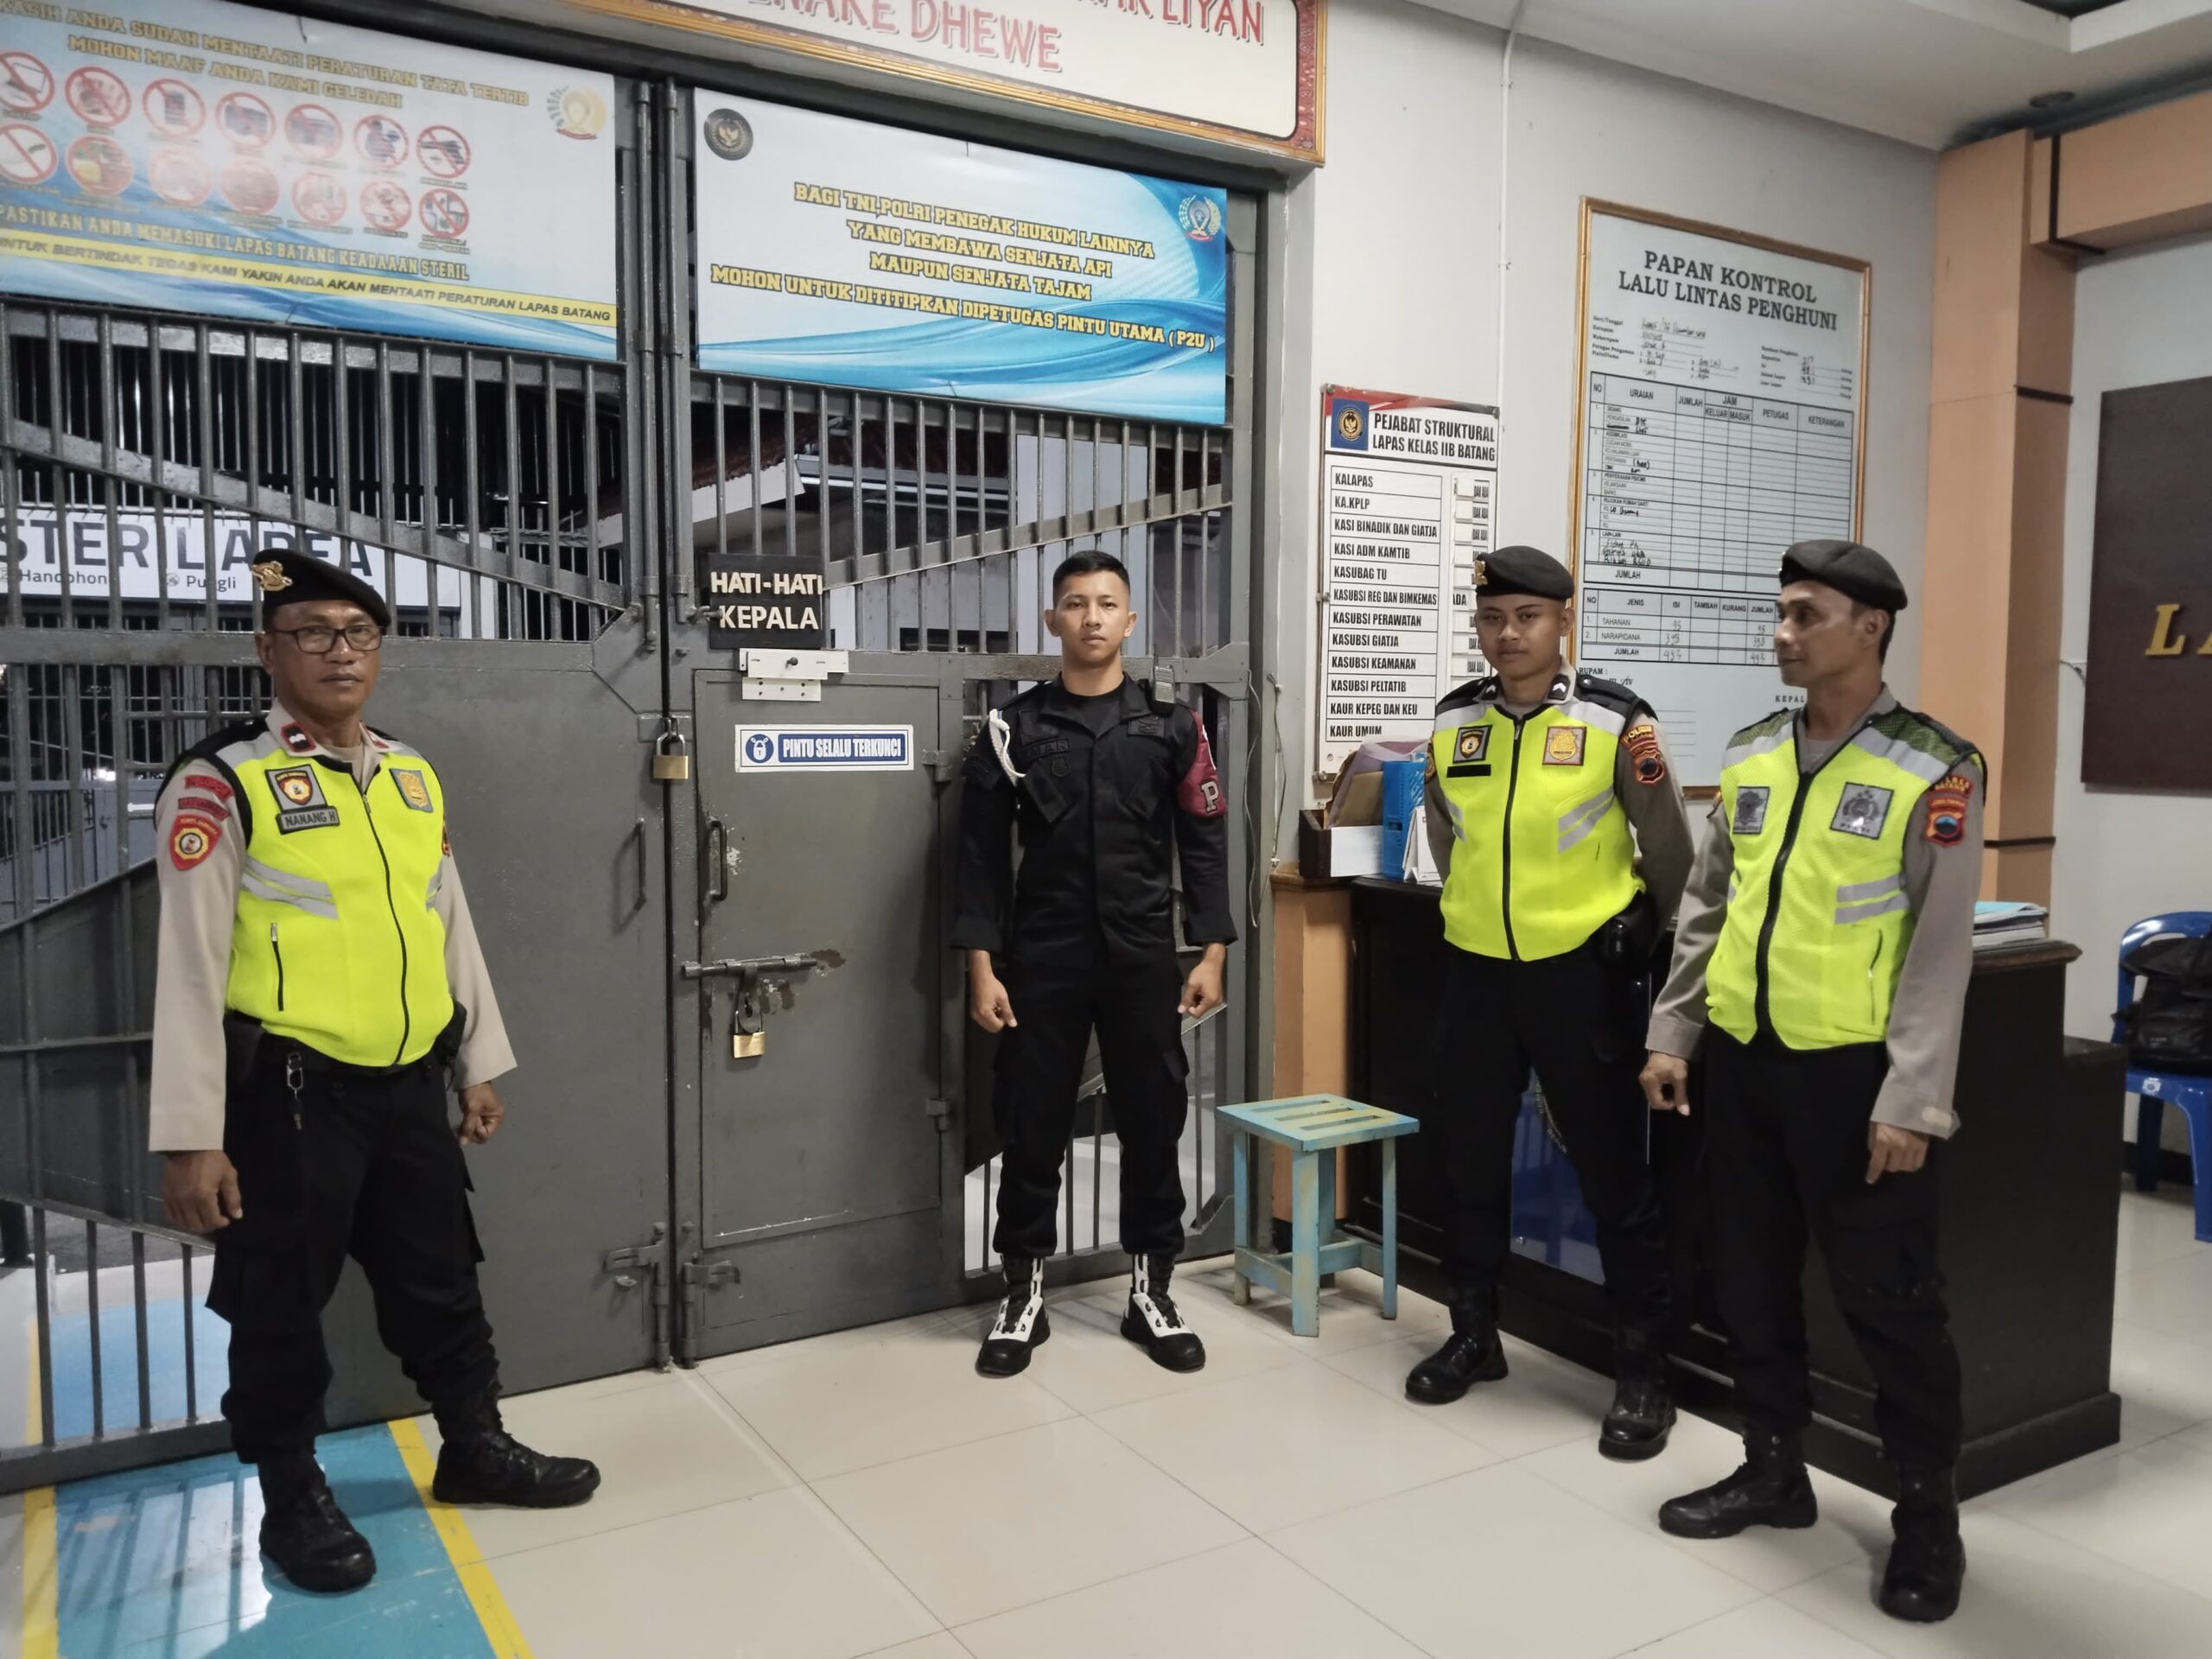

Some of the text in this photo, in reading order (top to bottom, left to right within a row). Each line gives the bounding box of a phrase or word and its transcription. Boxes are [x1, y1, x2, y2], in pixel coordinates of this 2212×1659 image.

[912, 0, 1060, 71] DHEWE
[66, 9, 126, 34] ANDA
[130, 20, 199, 48] SUDAH
[202, 34, 304, 68] MENTAATI
[307, 54, 417, 87] PERATURAN
[470, 83, 529, 106] TERTIB
[68, 35, 403, 108] MOHON MAAF ANDA KAMI GELEDAH
[794, 182, 841, 207] BAGI
[934, 207, 1015, 236] PENEGAK
[1016, 220, 1077, 246] HUKUM
[1080, 231, 1155, 259] LAINNYA
[88, 216, 132, 238] ANDA
[137, 223, 220, 250] MEMASUKI
[224, 234, 274, 257] LAPAS
[276, 241, 336, 264] BATANG
[421, 261, 469, 281] STERIL
[847, 219, 1112, 278] YANG MEMBAWA SENJATA API
[870, 251, 1091, 301] MAUPUN SENJATA TAJAM
[1643, 250, 1817, 304] PAPAN KONTROL
[200, 263, 237, 276] KAMI
[241, 268, 283, 283] YAKIN
[285, 274, 325, 289] ANDA
[326, 279, 365, 292] AKAN
[369, 284, 435, 300] MENTAATI
[438, 291, 515, 309] PERATURAN
[518, 301, 558, 315] LAPAS
[562, 306, 611, 321] BATANG
[1618, 270, 1669, 298] LALU
[1674, 278, 1741, 310] LINTAS
[1745, 295, 1837, 332] PENGHUNI
[711, 264, 782, 292] MOHON
[785, 274, 853, 302] UNTUK
[855, 283, 960, 316] DITITIPKAN
[962, 300, 1054, 329] DIPETUGAS
[1057, 312, 1106, 335] PINTU
[1109, 321, 1165, 344] UTAMA
[1630, 389, 1654, 400] URAIAN
[1679, 396, 1703, 407] JUMLAH
[1722, 397, 1737, 406] JAM
[1763, 409, 1789, 420] PETUGAS
[1808, 416, 1845, 428] KETERANGAN
[1705, 408, 1751, 421] KELUAR MASUK
[1374, 412, 1495, 443] PEJABAT STRUKTURAL
[1373, 433, 1496, 462] LAPAS KELAS IIB BATANG
[1334, 473, 1374, 488] KALAPAS
[1334, 496, 1370, 511] KA.KPLP
[1334, 518, 1438, 538] KASI BINADIK DAN GIATJA
[1334, 543, 1410, 560] KASI ADM KAMTIB
[187, 575, 236, 592] Pugli
[711, 571, 823, 594] HATI-HATI
[1334, 566, 1388, 582] KASUBAG TU
[1615, 569, 1640, 580] JUMLAH
[1333, 588, 1437, 606] KASUBSI REG DAN BIMKEMAS
[720, 605, 819, 630] KEPALA
[1332, 612, 1422, 627] KASUBSI PERAWATAN
[1603, 618, 1630, 626] TAHANAN
[1332, 633, 1399, 648] KASUBSI GIATJA
[1601, 632, 1641, 641] NARAPIDANA
[1332, 656, 1416, 671] KASUBSI KEAMANAN
[1331, 678, 1407, 693] KASUBSI PELTATIB
[1330, 702, 1418, 716] KAUR KEPEG DAN KEU
[1330, 724, 1353, 738] KAUR
[783, 737, 901, 758] PINTU SELALU TERKUNCI
[1201, 780, 1219, 813] P
